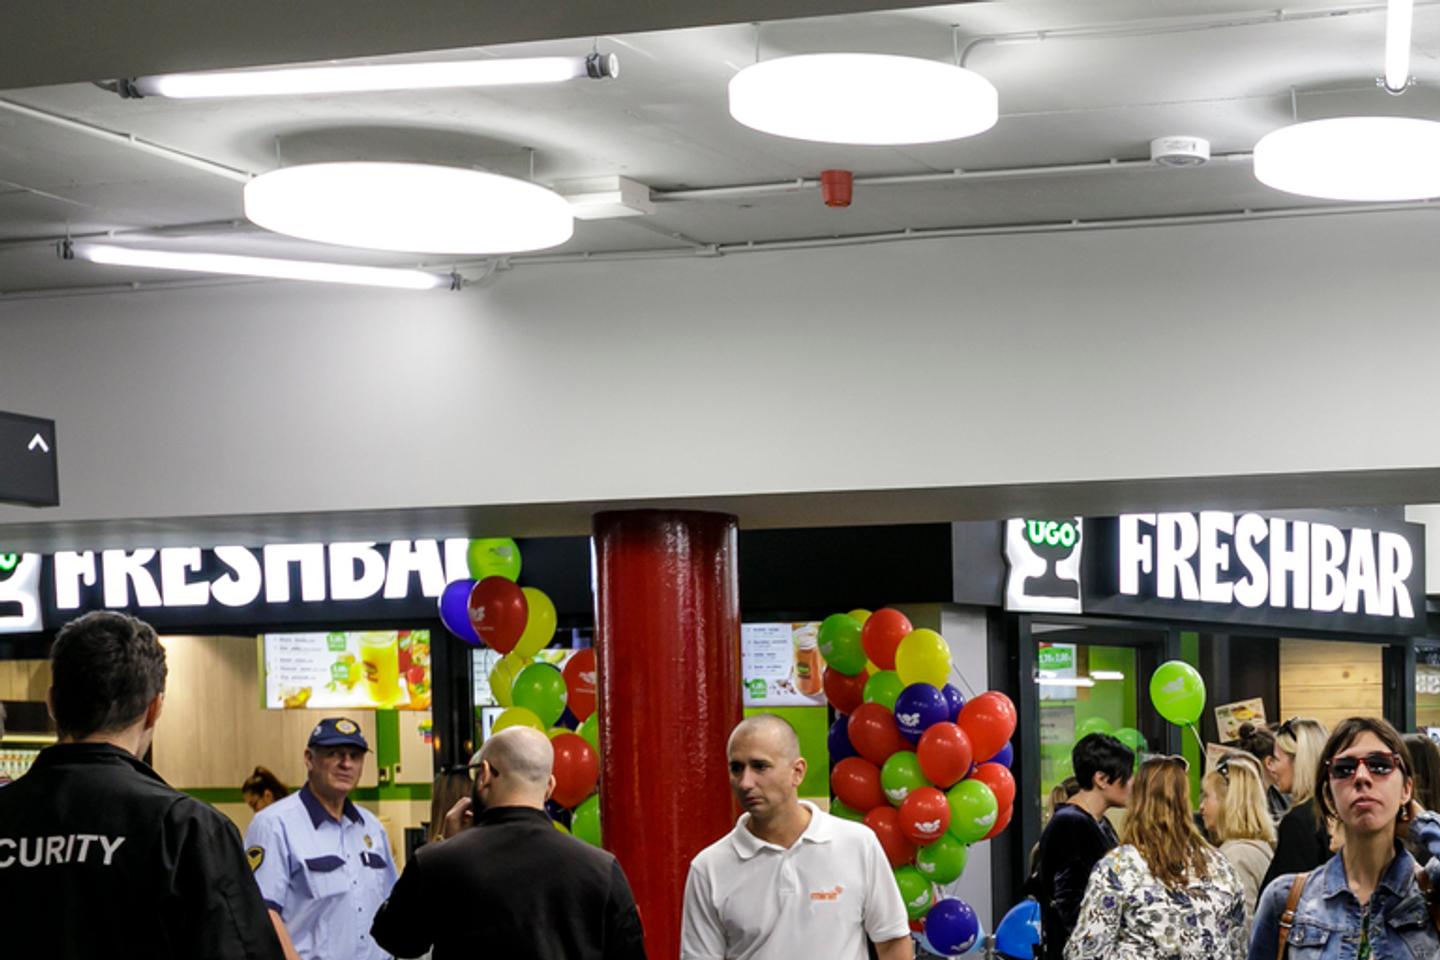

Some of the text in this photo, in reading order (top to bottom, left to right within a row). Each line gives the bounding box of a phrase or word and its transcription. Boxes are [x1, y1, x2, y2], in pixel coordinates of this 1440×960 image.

[1027, 519, 1076, 547] UGO
[1119, 511, 1415, 618] FRESHBAR
[0, 833, 126, 868] CURITY
